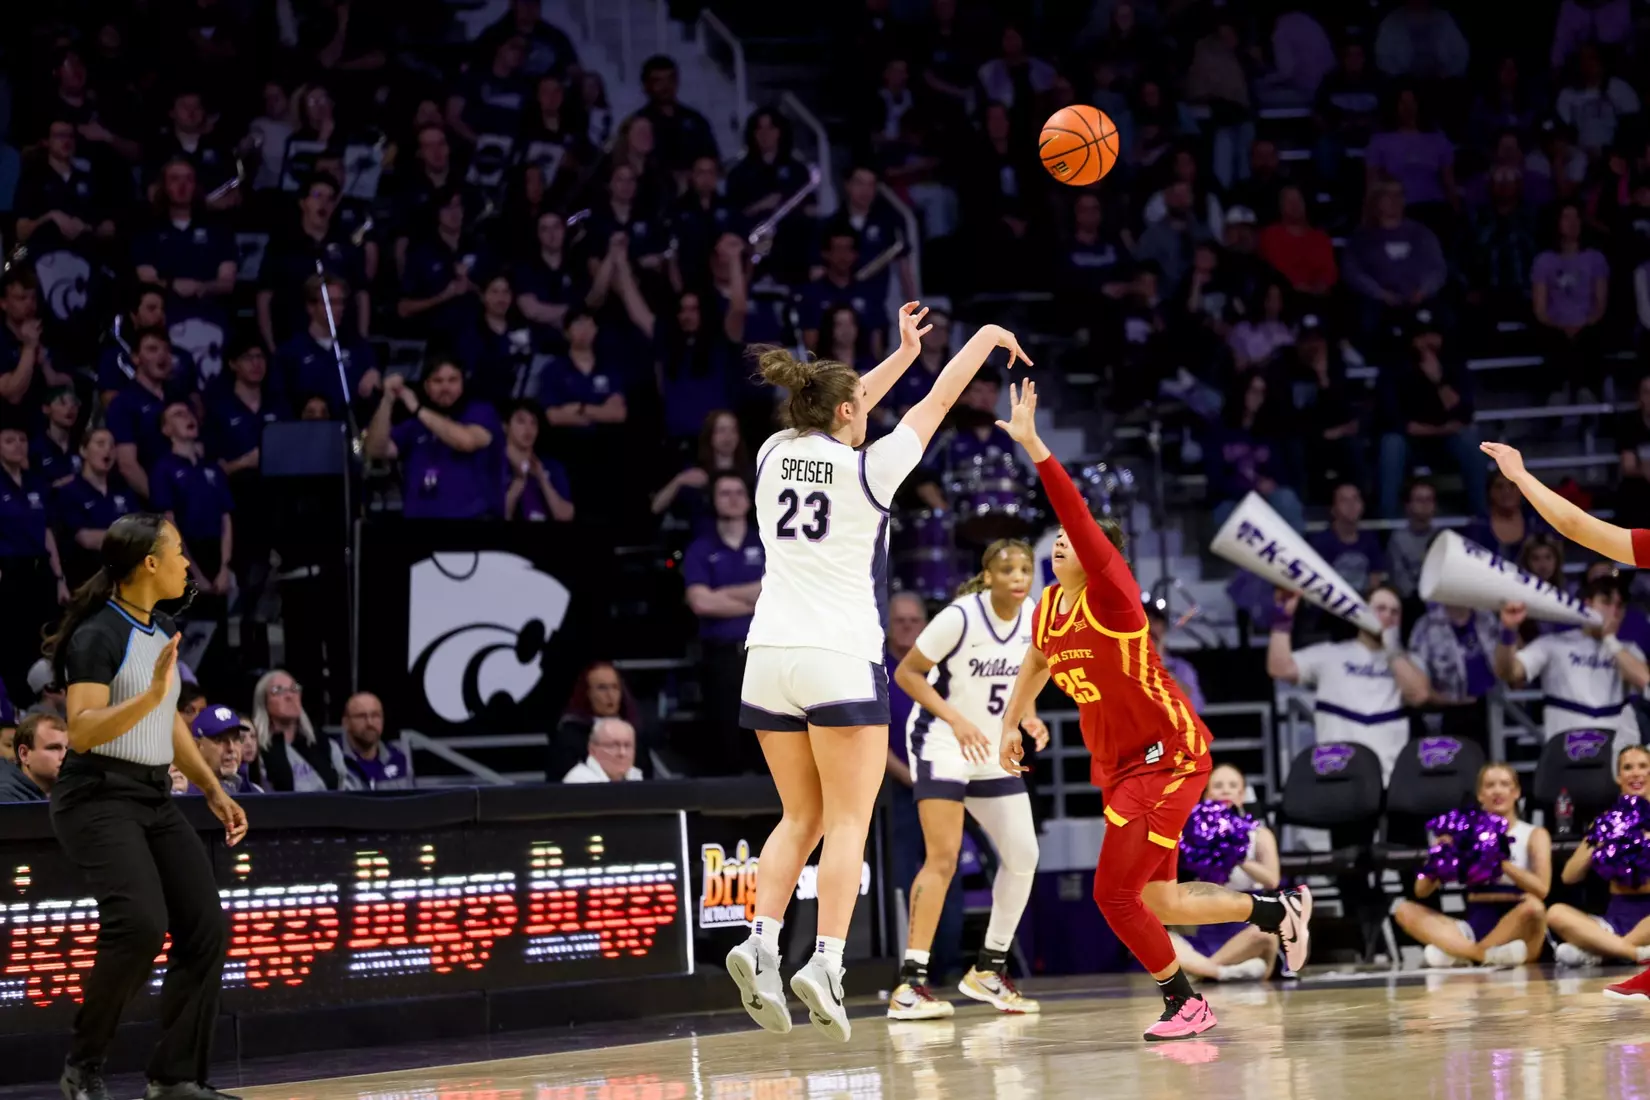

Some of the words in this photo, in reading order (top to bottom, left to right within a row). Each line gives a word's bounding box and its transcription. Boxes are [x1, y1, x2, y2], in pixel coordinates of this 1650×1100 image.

[781, 457, 833, 484] SPEISER
[776, 487, 831, 543] 23
[1258, 539, 1361, 620] K-STATE
[1489, 552, 1592, 619] KSTATE
[969, 658, 1020, 677] Wildca
[1060, 648, 1095, 661] STATE
[987, 683, 1008, 715] 5
[1054, 666, 1102, 704] 25
[702, 840, 760, 923] Brig
